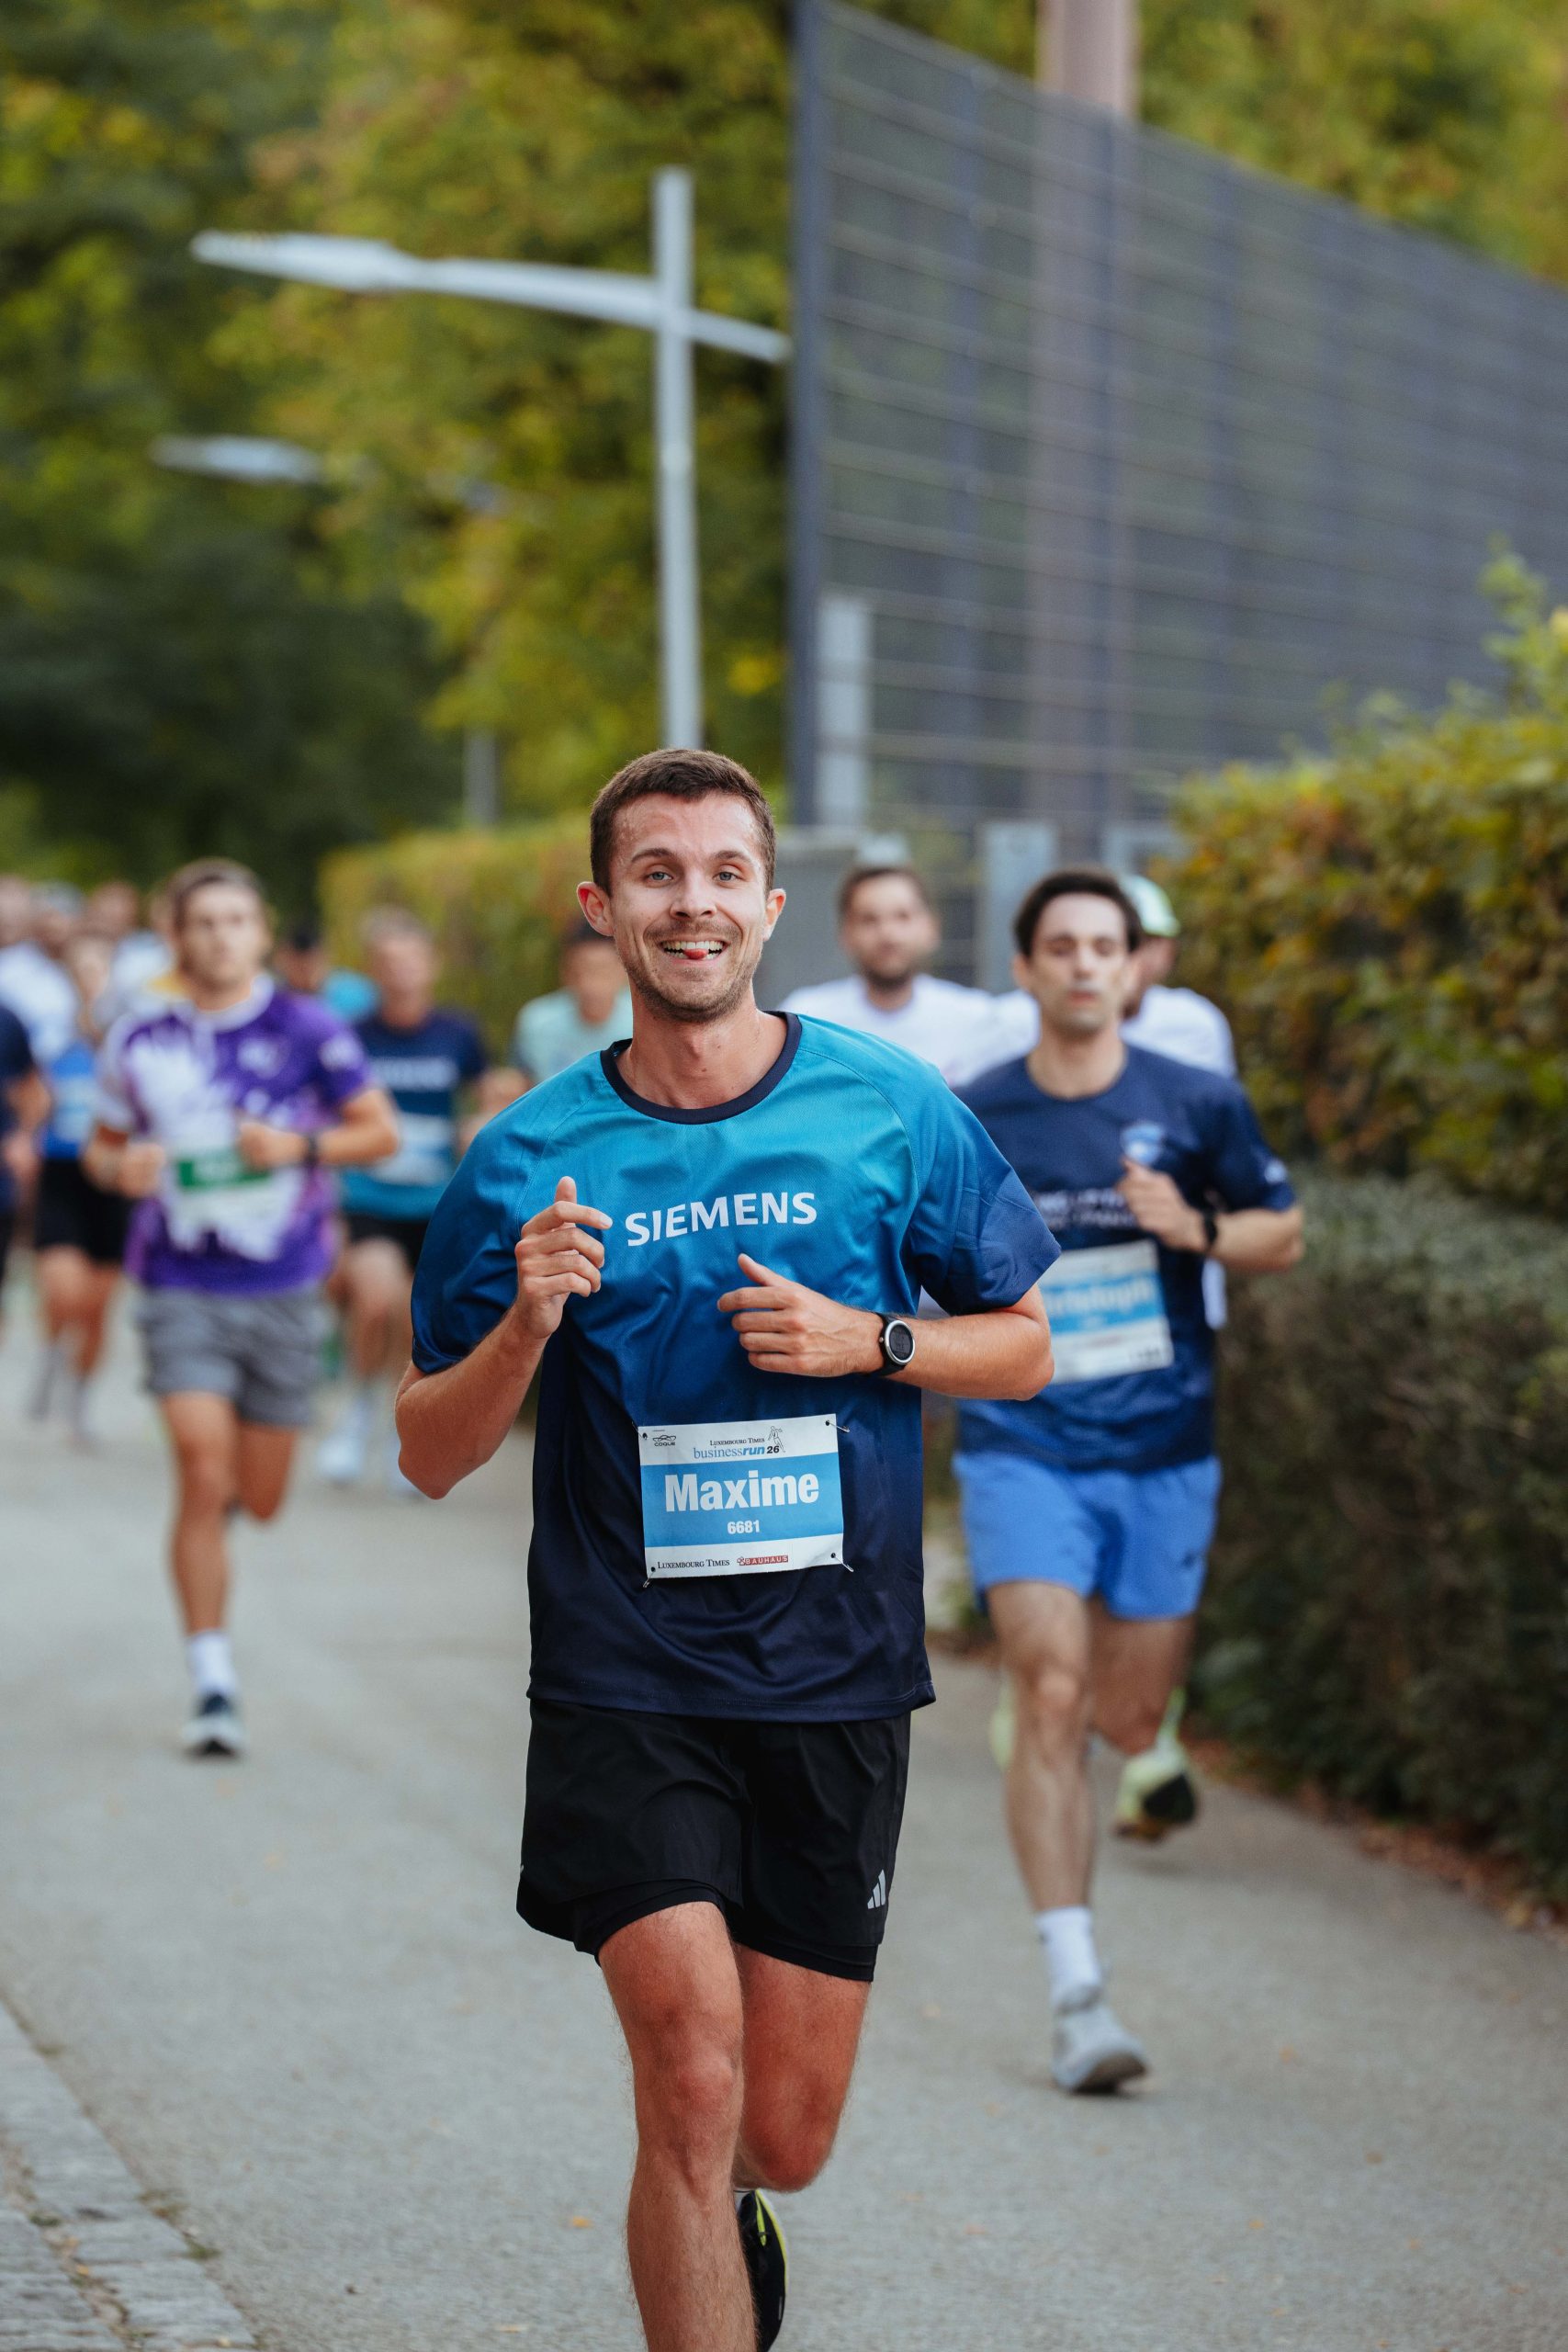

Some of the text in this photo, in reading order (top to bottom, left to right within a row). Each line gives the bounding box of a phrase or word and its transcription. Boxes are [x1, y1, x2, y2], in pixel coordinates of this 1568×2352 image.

[625, 1192, 818, 1247] SIEMENS
[664, 1470, 819, 1512] Maxime
[727, 1520, 761, 1535] 6681
[657, 1558, 730, 1569] LUXEMBOURG TIMES
[745, 1555, 788, 1566] BAUHAUS
